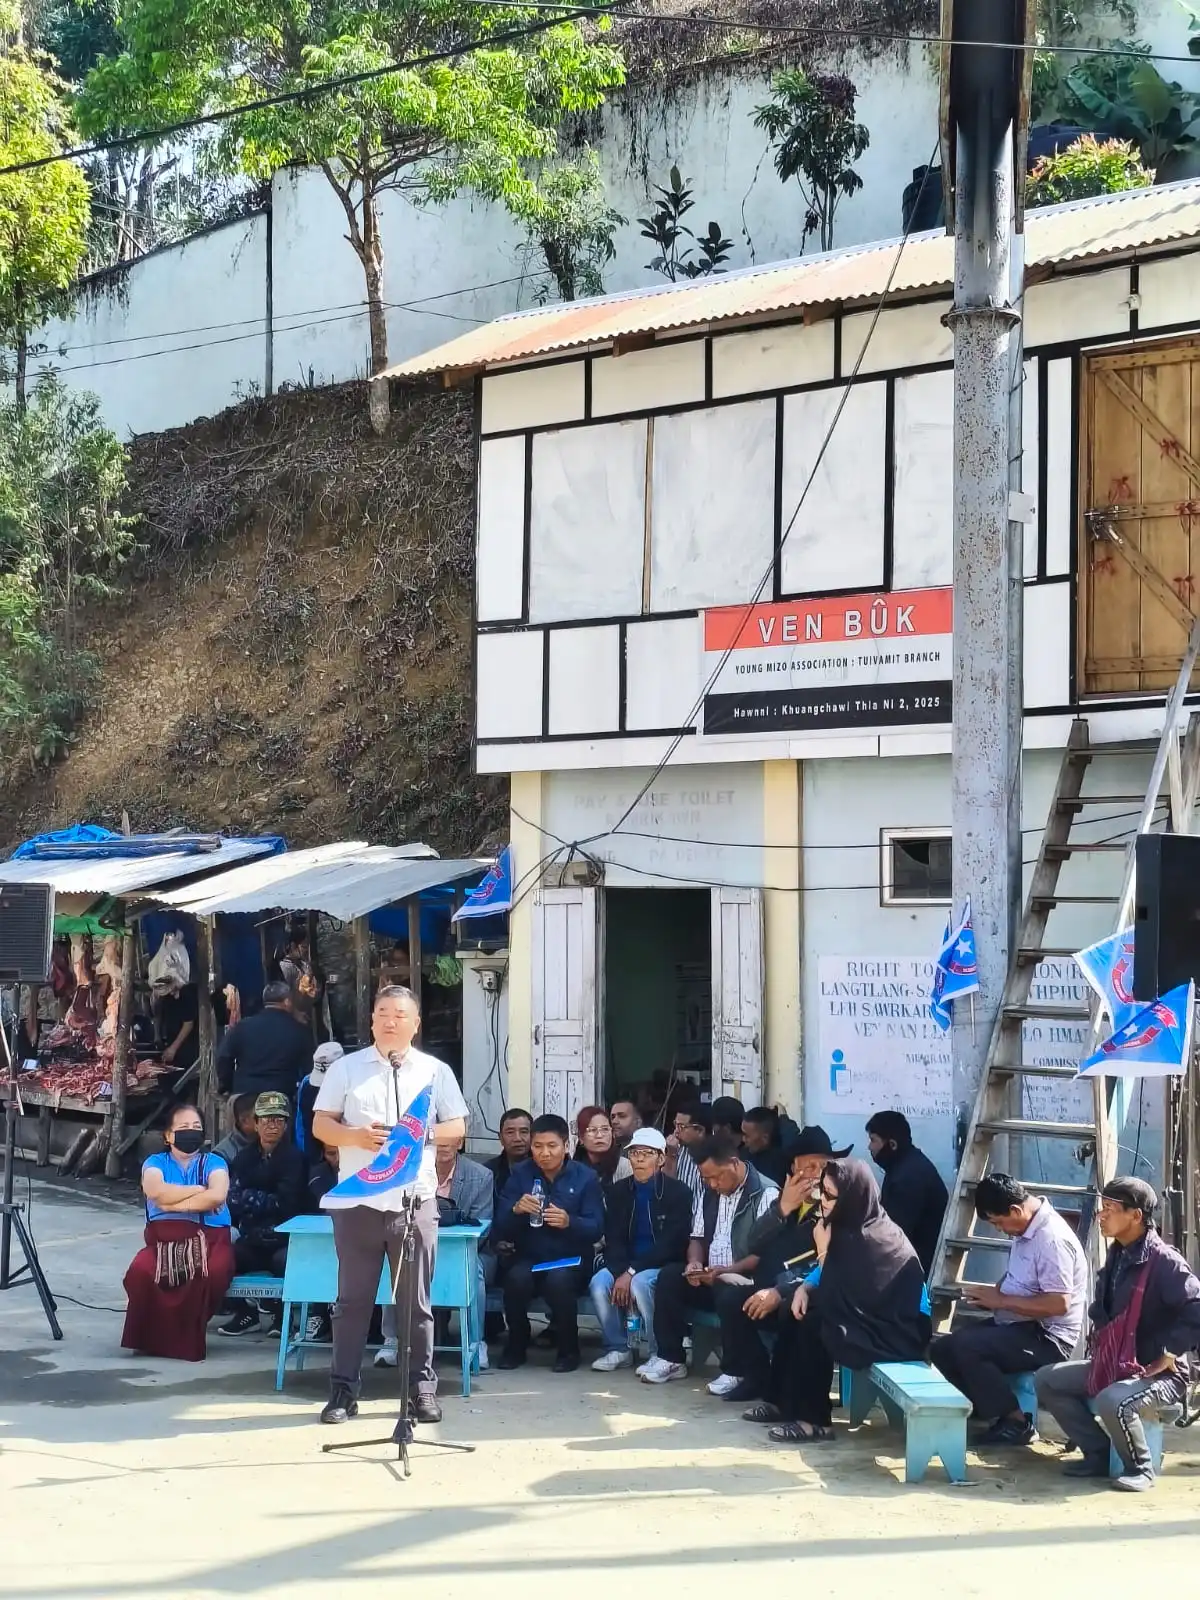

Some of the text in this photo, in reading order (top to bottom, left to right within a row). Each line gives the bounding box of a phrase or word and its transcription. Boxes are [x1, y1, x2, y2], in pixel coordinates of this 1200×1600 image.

[757, 598, 916, 644] VEN BÛK
[735, 664, 763, 675] YOUNG
[766, 662, 787, 673] MIZO
[790, 657, 848, 671] ASSOCIATION
[858, 653, 901, 666] TUIVAMIT
[904, 651, 941, 664] BRANCH
[899, 698, 909, 711] 2,
[914, 696, 940, 708] 2025
[679, 789, 736, 807] TOILET
[846, 961, 900, 978] RIGHT
[910, 963, 935, 979] TO
